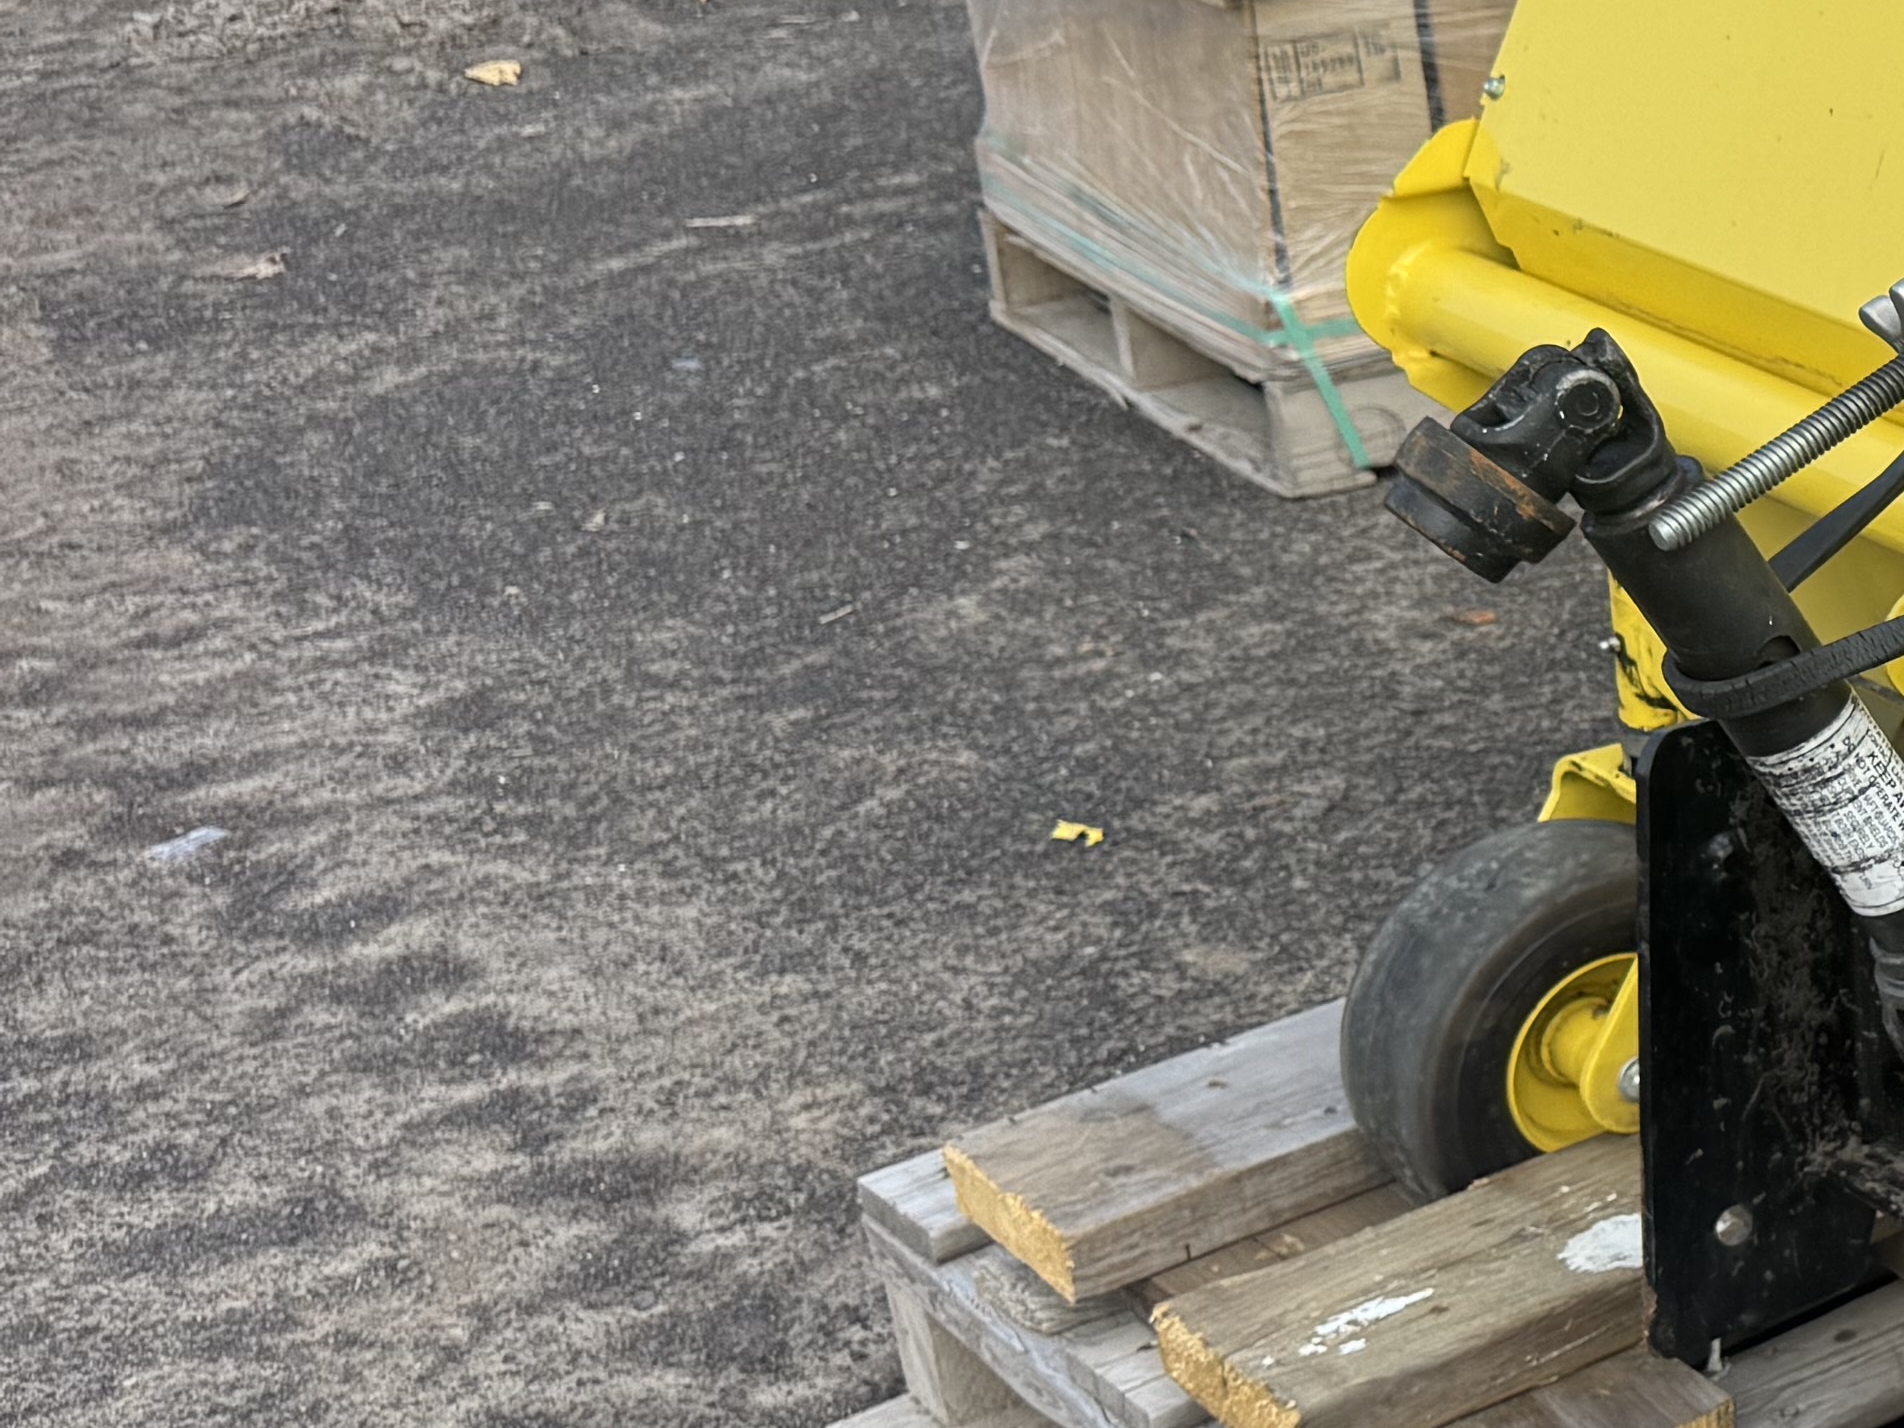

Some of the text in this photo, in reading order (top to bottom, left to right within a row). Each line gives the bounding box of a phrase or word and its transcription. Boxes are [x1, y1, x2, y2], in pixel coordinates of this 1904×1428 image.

[1840, 735, 1857, 754] DO
[1851, 752, 1871, 775] NOT
[1865, 773, 1902, 821] OPERATE
[1865, 750, 1898, 791] KEEP
[1856, 785, 1879, 813] HAFT
